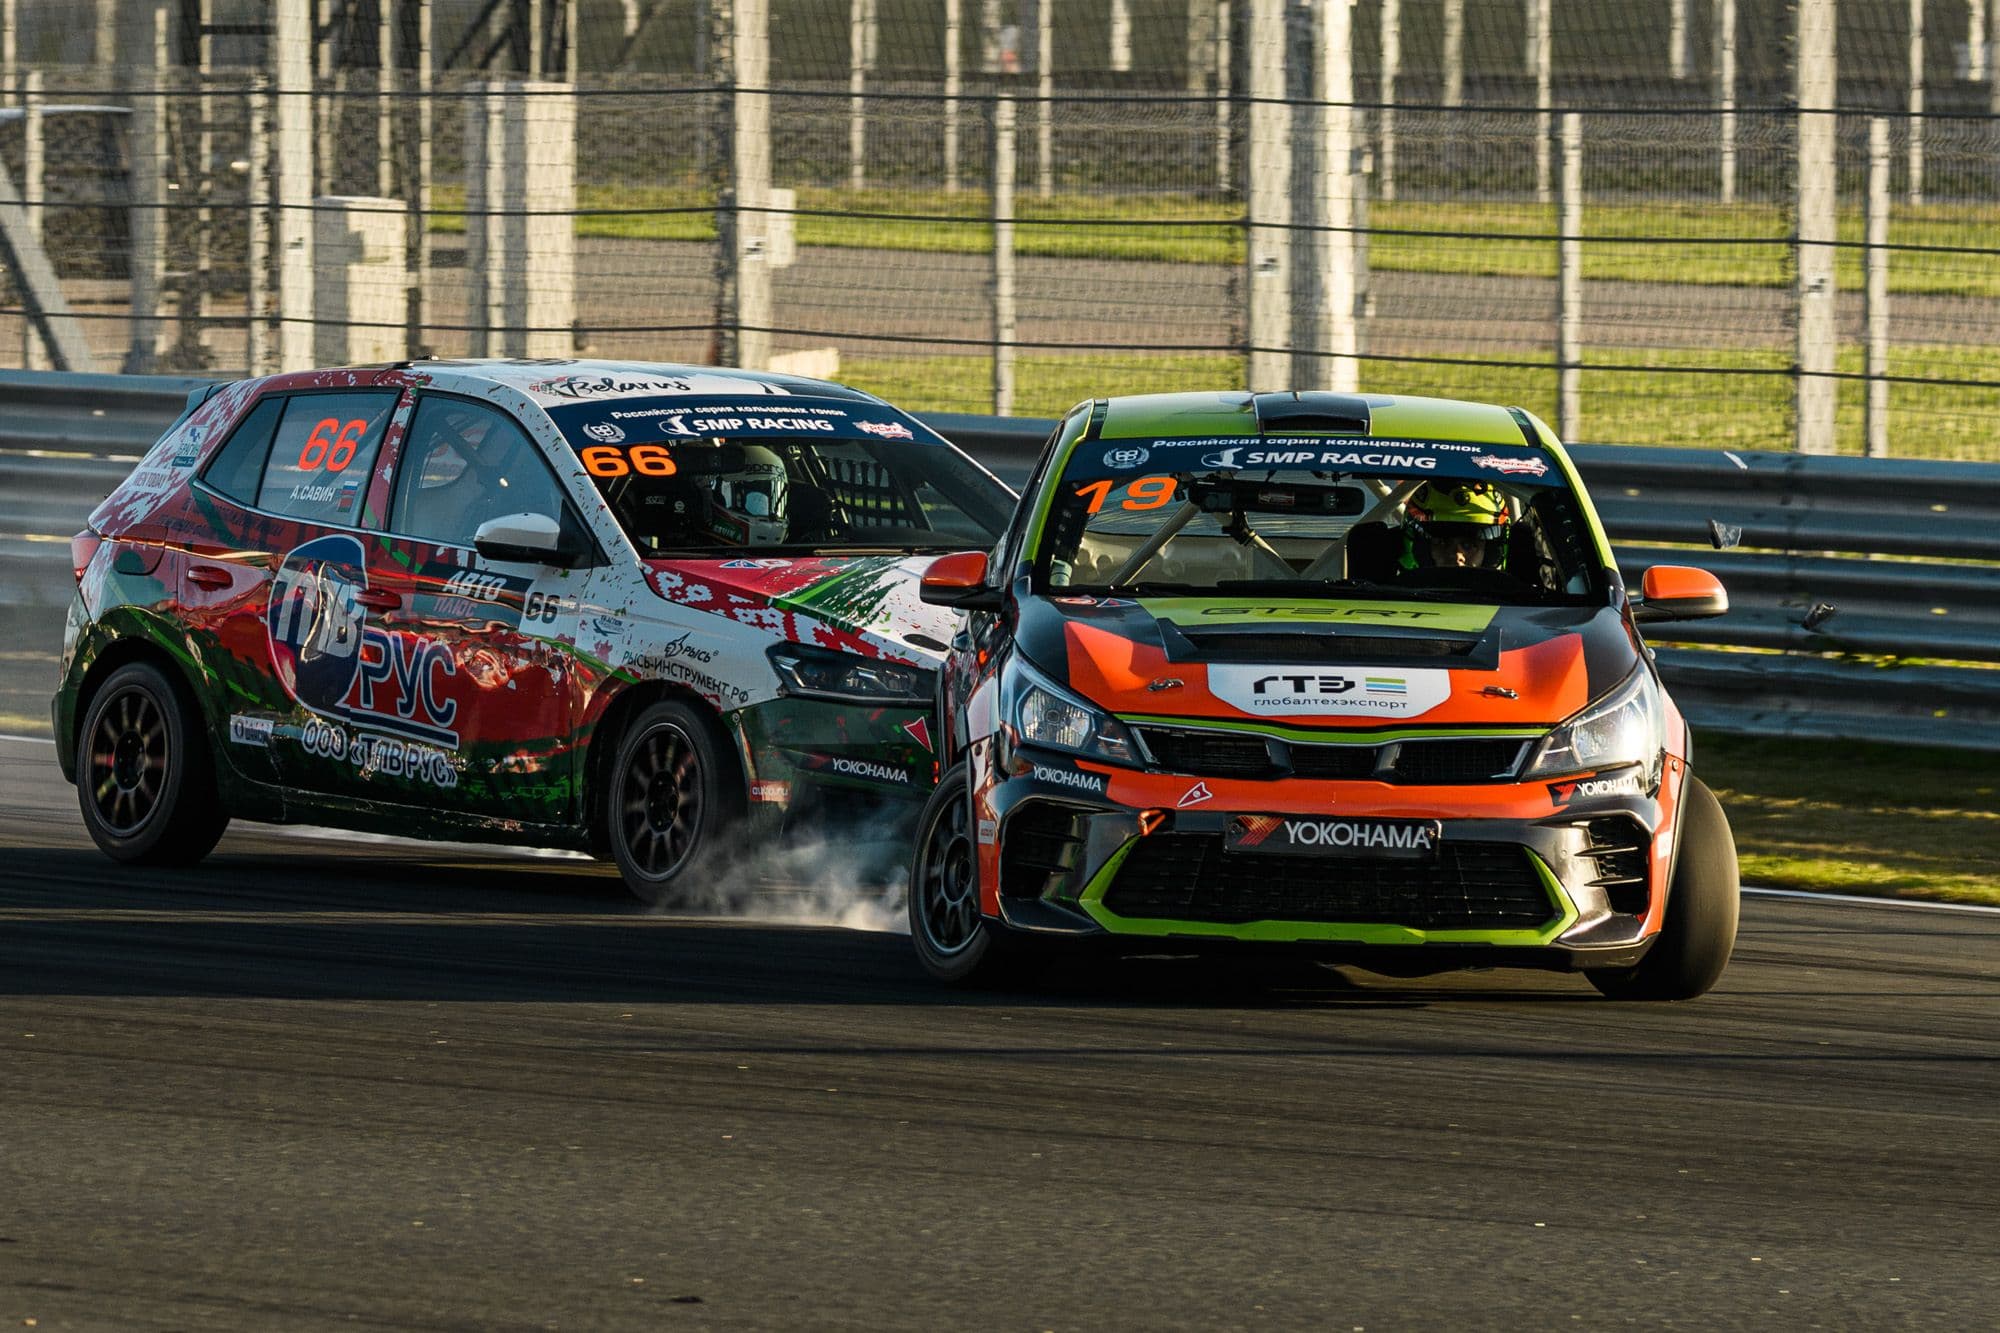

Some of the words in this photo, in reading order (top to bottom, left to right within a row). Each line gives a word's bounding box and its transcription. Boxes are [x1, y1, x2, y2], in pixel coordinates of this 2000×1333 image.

[611, 408, 692, 419] Российская
[694, 405, 735, 415] серия
[736, 405, 809, 414] кольцевых
[810, 407, 848, 417] гонок
[692, 418, 743, 432] SMP
[746, 417, 835, 431] RACING
[298, 417, 367, 472] 66
[1152, 437, 1260, 448] Российская
[1266, 437, 1320, 447] серия
[1326, 438, 1425, 449] кольцевых
[1431, 443, 1482, 453] гонок
[581, 445, 677, 477] 66
[1246, 452, 1315, 464] SMP
[1320, 452, 1437, 468] RACING
[290, 485, 336, 502] А.САВИН
[1074, 476, 1178, 514] 19
[442, 570, 507, 601] АВТО
[433, 596, 478, 617] ПЛЮС
[525, 591, 561, 624] 66
[359, 625, 457, 727] РУС
[622, 650, 749, 703] РЫСЬ-ИНСТРУМЕНТ.РФ
[1254, 696, 1408, 709] глобалтехэкспорт
[832, 757, 908, 783] YOKOHAMA
[1033, 765, 1101, 792] YOKOHAMA
[1577, 776, 1640, 797] YOKOHAMA
[1284, 820, 1431, 849] YOKOHAMA
